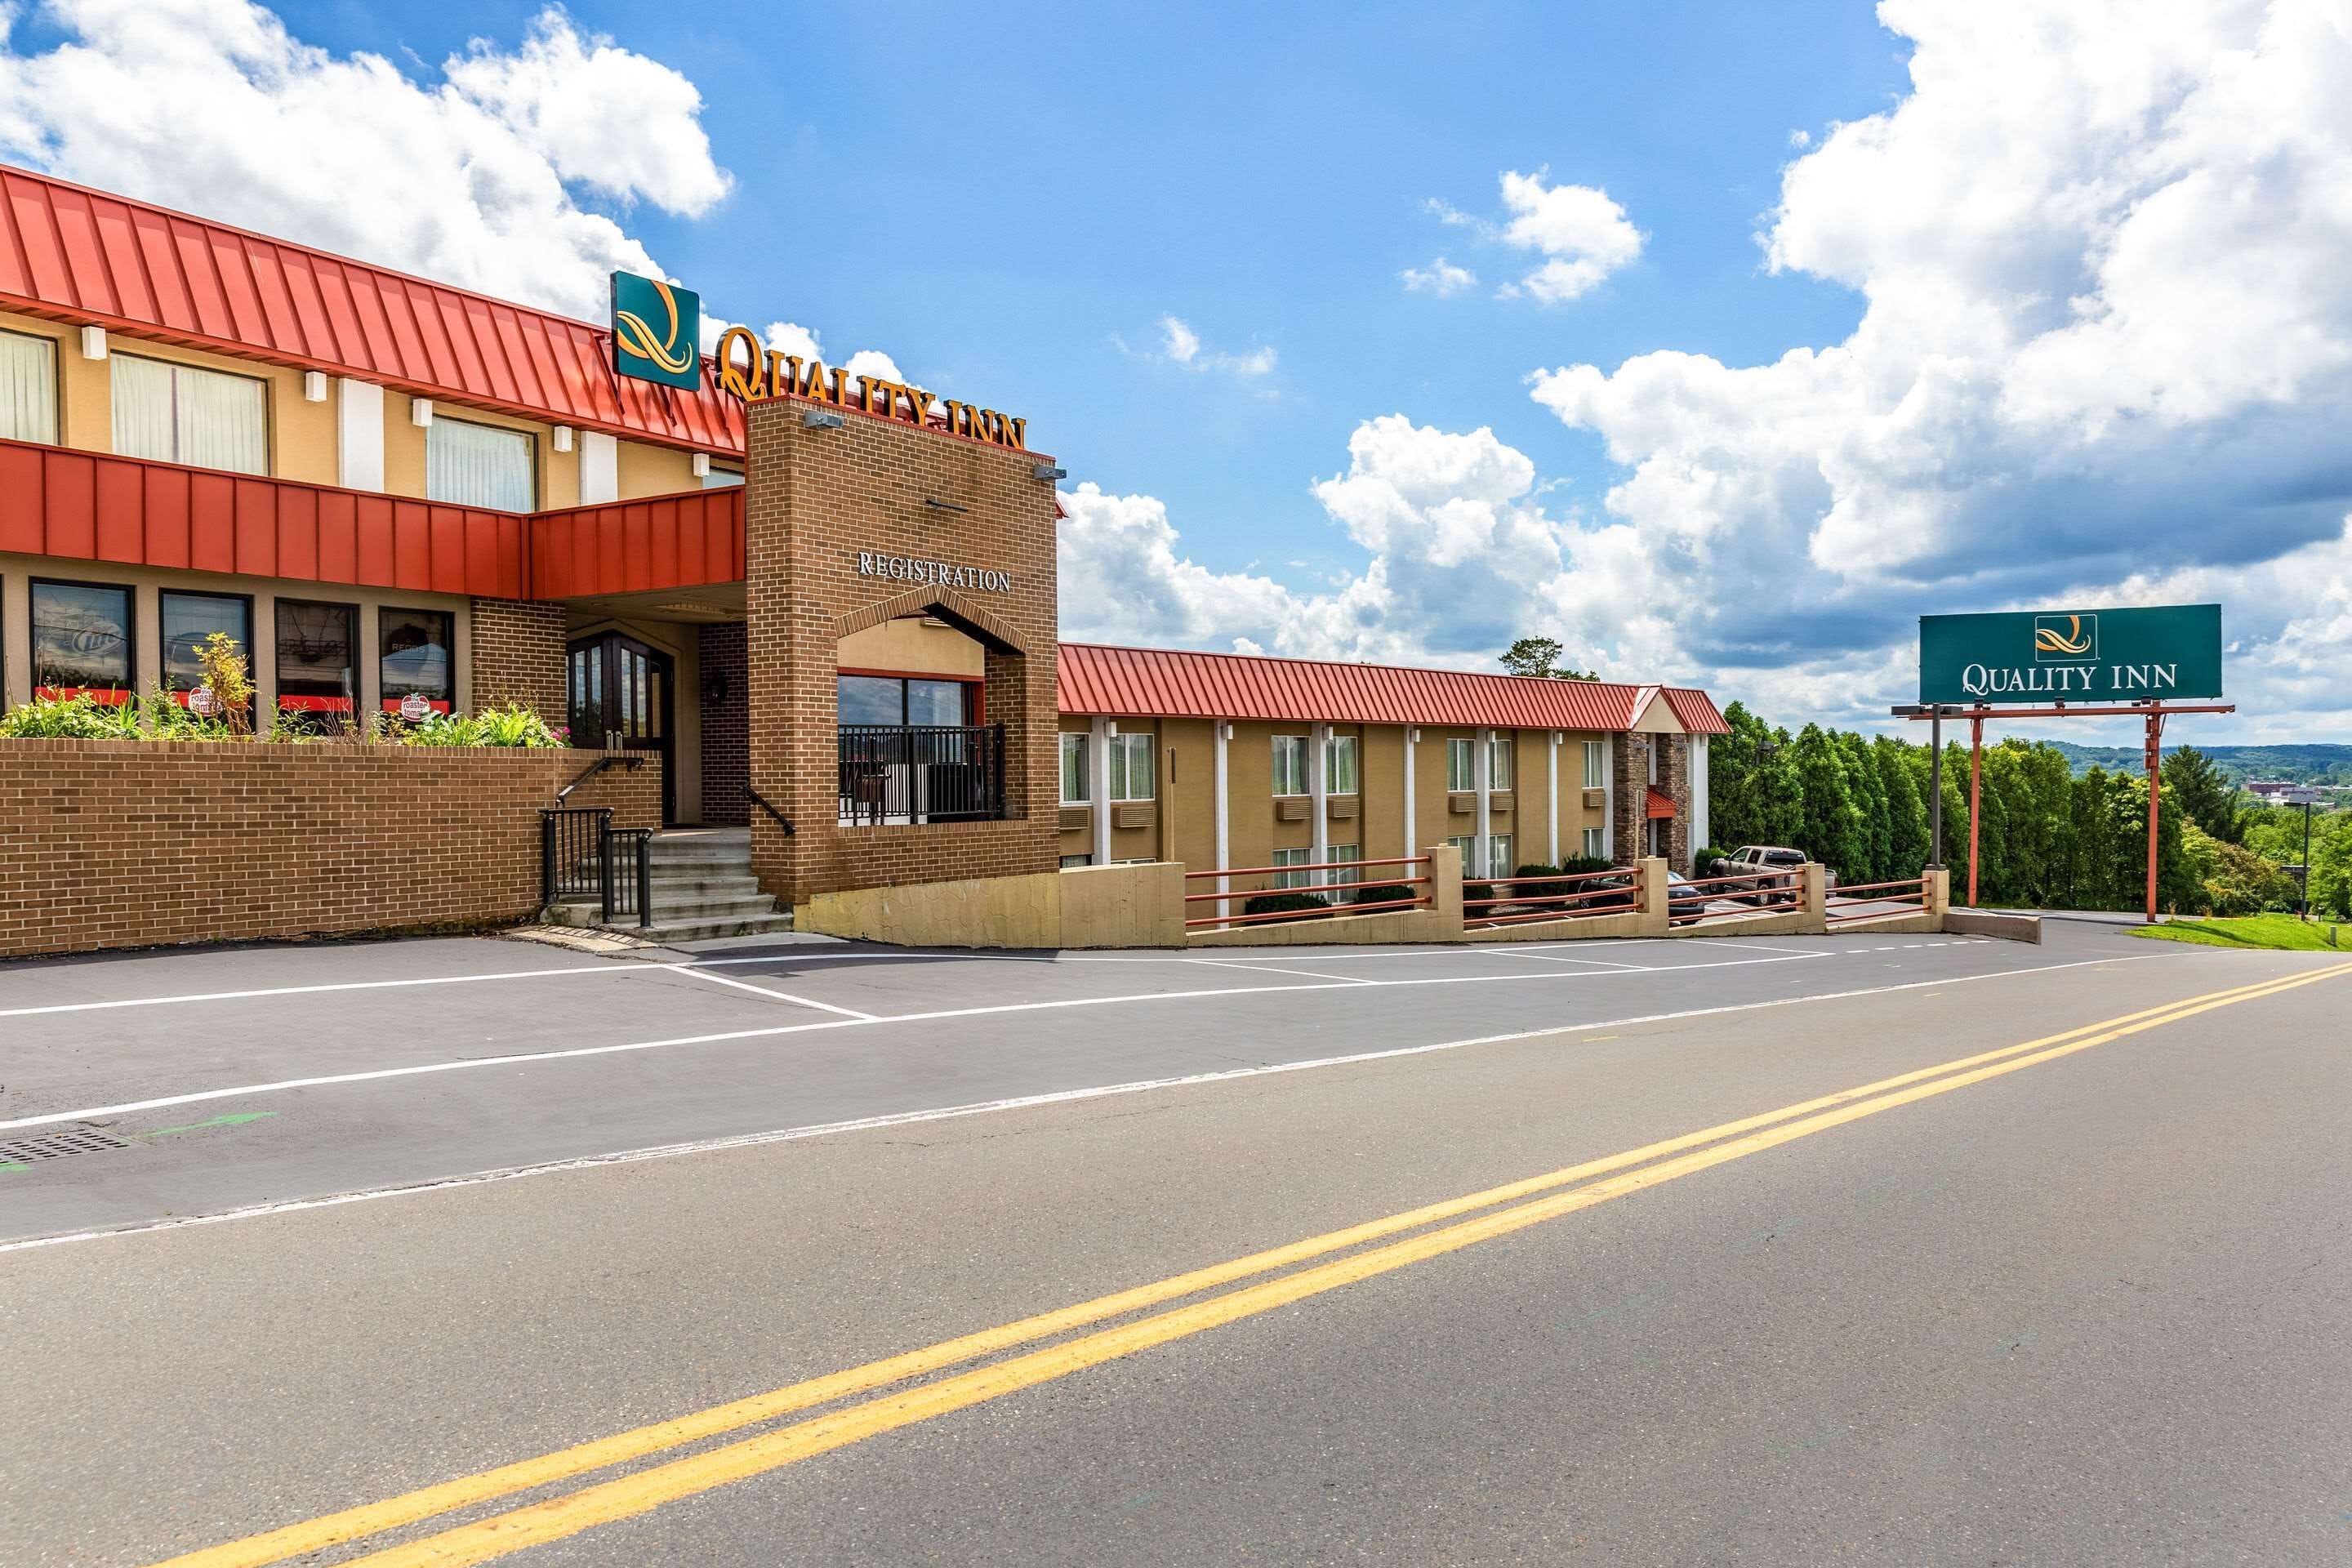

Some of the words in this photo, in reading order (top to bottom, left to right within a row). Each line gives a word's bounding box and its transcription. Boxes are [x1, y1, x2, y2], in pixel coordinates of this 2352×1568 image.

[715, 327, 935, 426] QUALITY
[943, 400, 1027, 449] INN
[859, 552, 1010, 592] REGISTRATION
[1962, 664, 2096, 696] QUALITY
[2111, 664, 2178, 689] INN
